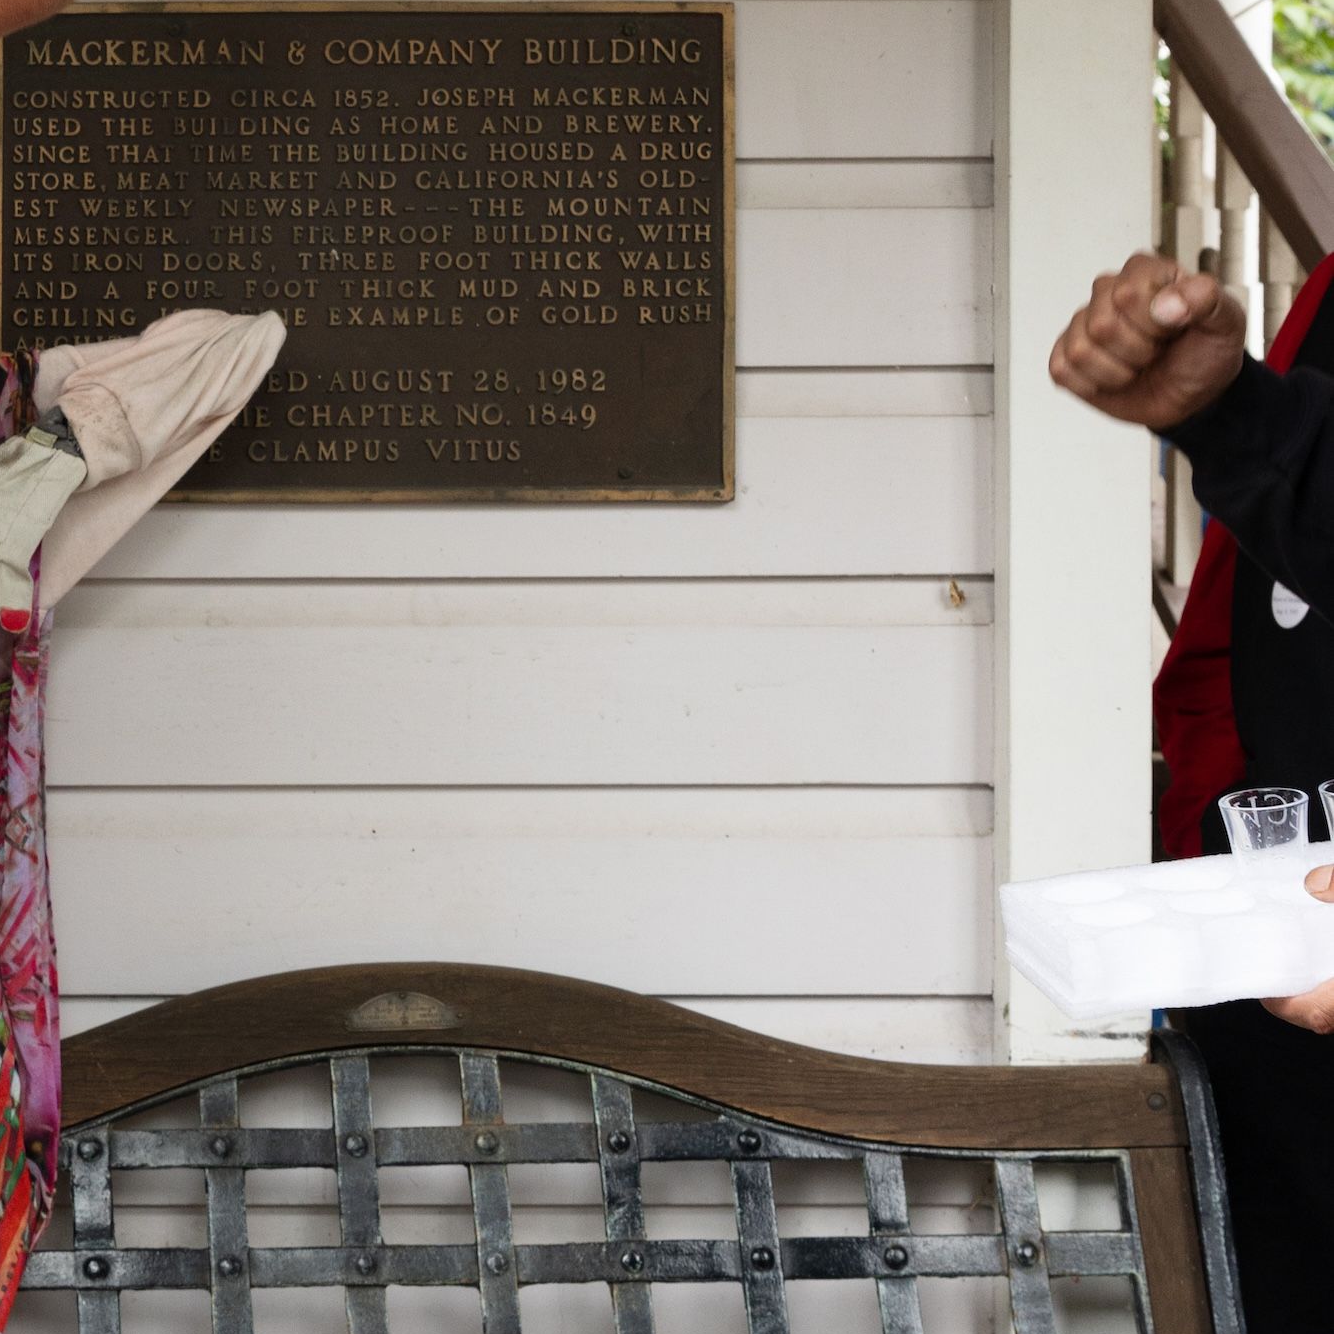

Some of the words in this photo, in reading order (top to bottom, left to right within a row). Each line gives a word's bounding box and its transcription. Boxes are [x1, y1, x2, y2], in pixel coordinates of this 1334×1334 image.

[28, 39, 264, 67] MACKERMAN
[287, 40, 306, 65] &
[324, 38, 502, 65] COMPANY
[525, 37, 701, 65] BUILDING
[14, 89, 212, 109] CONSTRUCTED
[231, 89, 317, 107] CIRCA
[335, 89, 399, 109] 1852.
[417, 87, 515, 107] JOSEPH
[533, 86, 709, 106] MACKERMAN
[14, 144, 91, 164] SINCE
[106, 144, 173, 164] THAT
[190, 144, 254, 164] TIME
[269, 143, 321, 163] THE
[337, 142, 468, 162] BUILDING
[489, 141, 595, 162] HOUSED
[610, 143, 628, 162] A
[640, 141, 711, 161] DRUG
[13, 170, 107, 193] STORE,
[116, 170, 189, 191] MEAT
[206, 170, 319, 190] MARKET
[337, 169, 398, 190] AND
[415, 169, 619, 190] CALIFORNIA'S
[639, 168, 712, 189] OLD-
[14, 252, 54, 272] ITS
[71, 252, 144, 272] IRON
[163, 250, 276, 272] DOORS,
[298, 249, 396, 271] THREE
[419, 251, 491, 271] FOOT
[511, 250, 602, 270] THICK
[618, 250, 710, 271] WALLS
[13, 307, 137, 327] CEILING
[329, 306, 465, 327] EXAMPLE
[485, 306, 521, 326] OF
[541, 305, 618, 324] GOLD
[639, 304, 710, 325] RUSH
[332, 368, 454, 393] AUGUST
[474, 368, 522, 396] 28,
[538, 367, 606, 392] 1982
[287, 403, 442, 427] CHAPTER
[456, 403, 511, 426] NO.
[528, 402, 598, 430] 1849
[249, 439, 400, 462] CLAMPUS
[425, 438, 521, 461] VITUS
